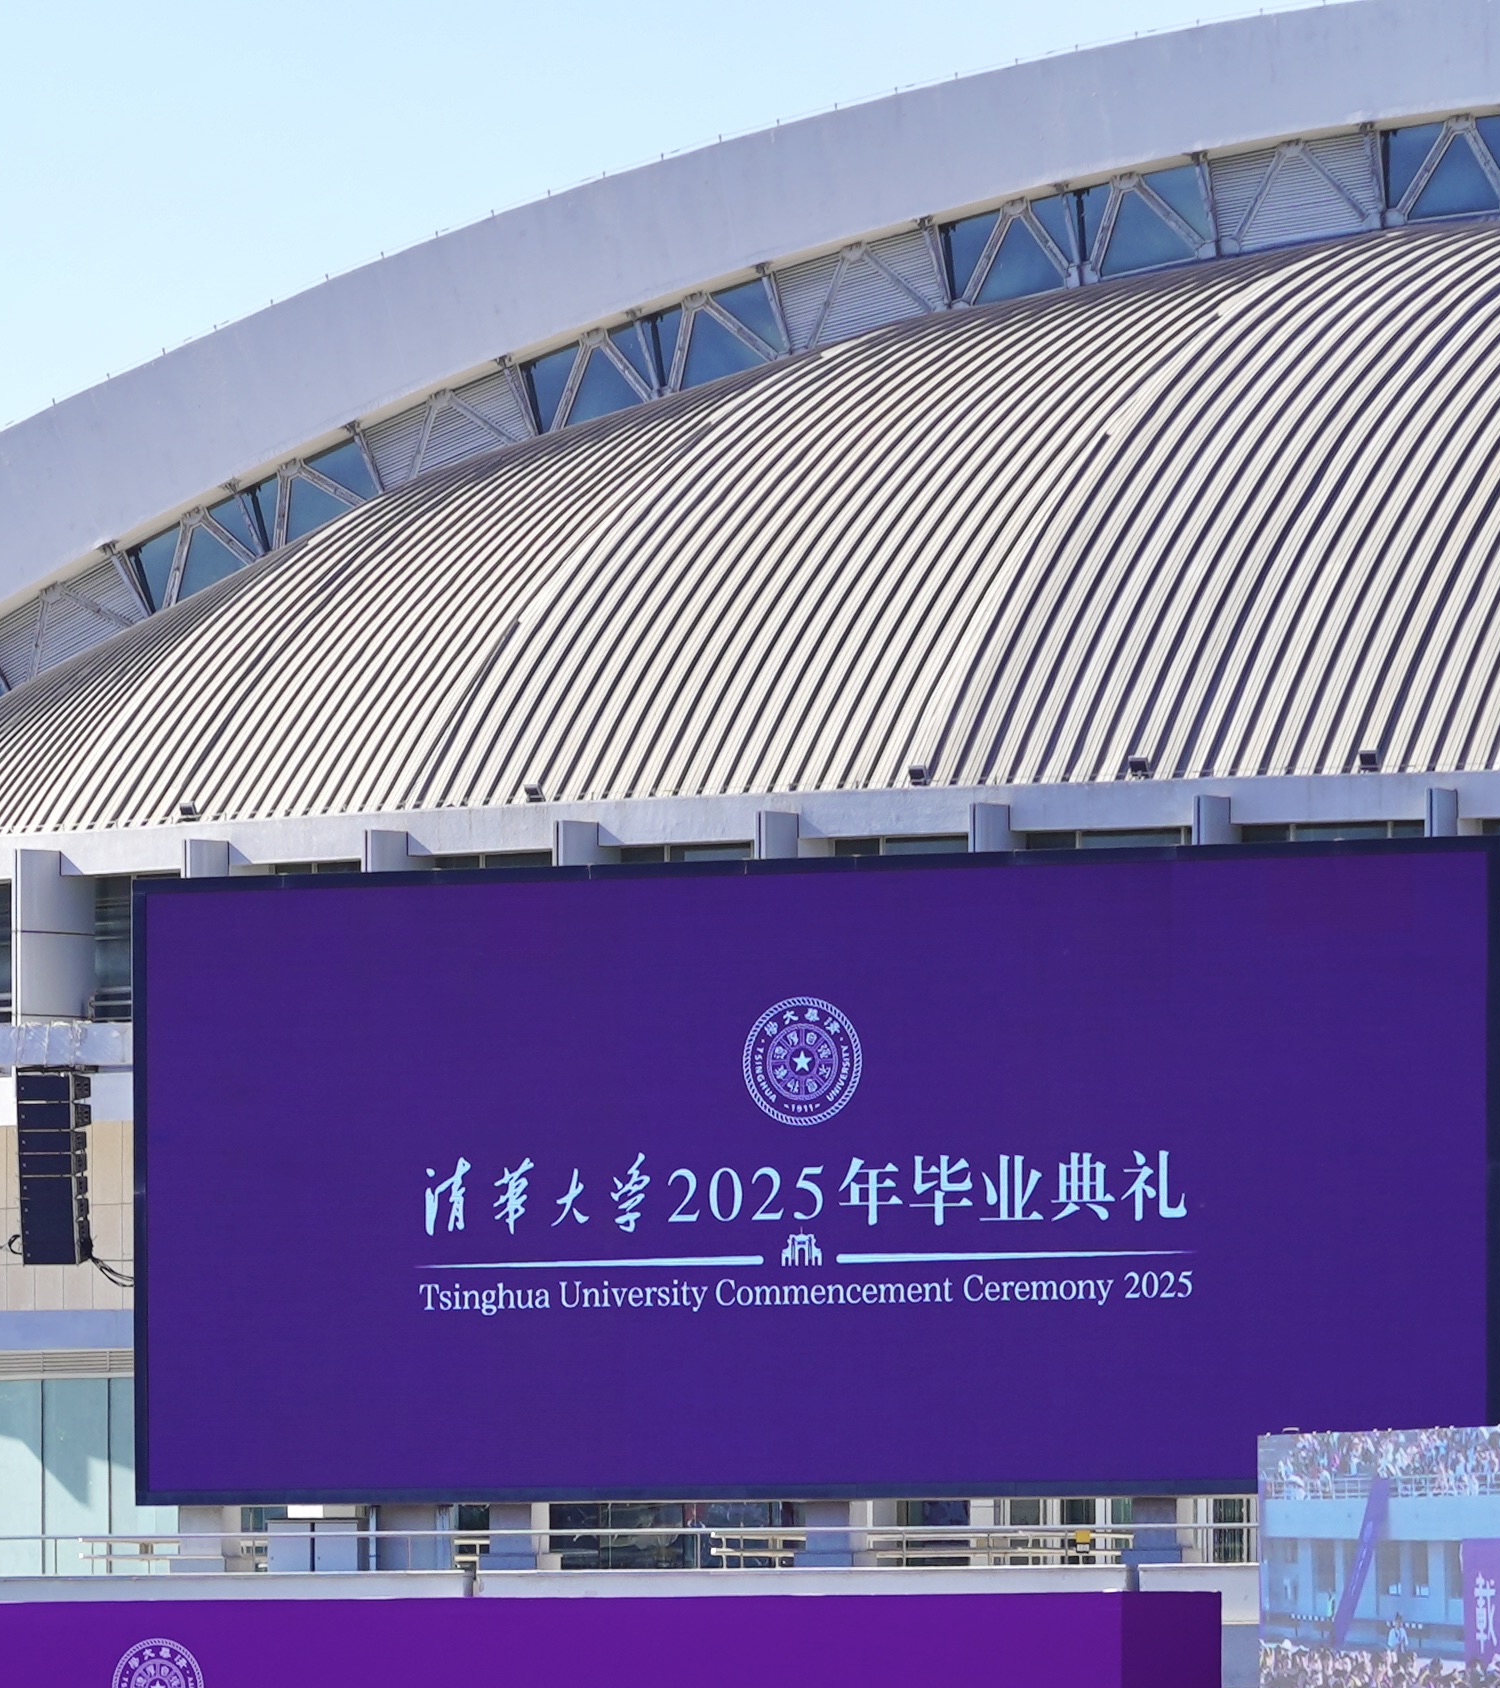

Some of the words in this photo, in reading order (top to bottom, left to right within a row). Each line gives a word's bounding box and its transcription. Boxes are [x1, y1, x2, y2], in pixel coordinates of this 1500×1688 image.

[419, 1282, 551, 1313] Tsinghua
[559, 1280, 708, 1314] University
[715, 1278, 953, 1305] Commencement
[964, 1274, 1114, 1306] Ceremony
[1124, 1271, 1193, 1299] 2025
